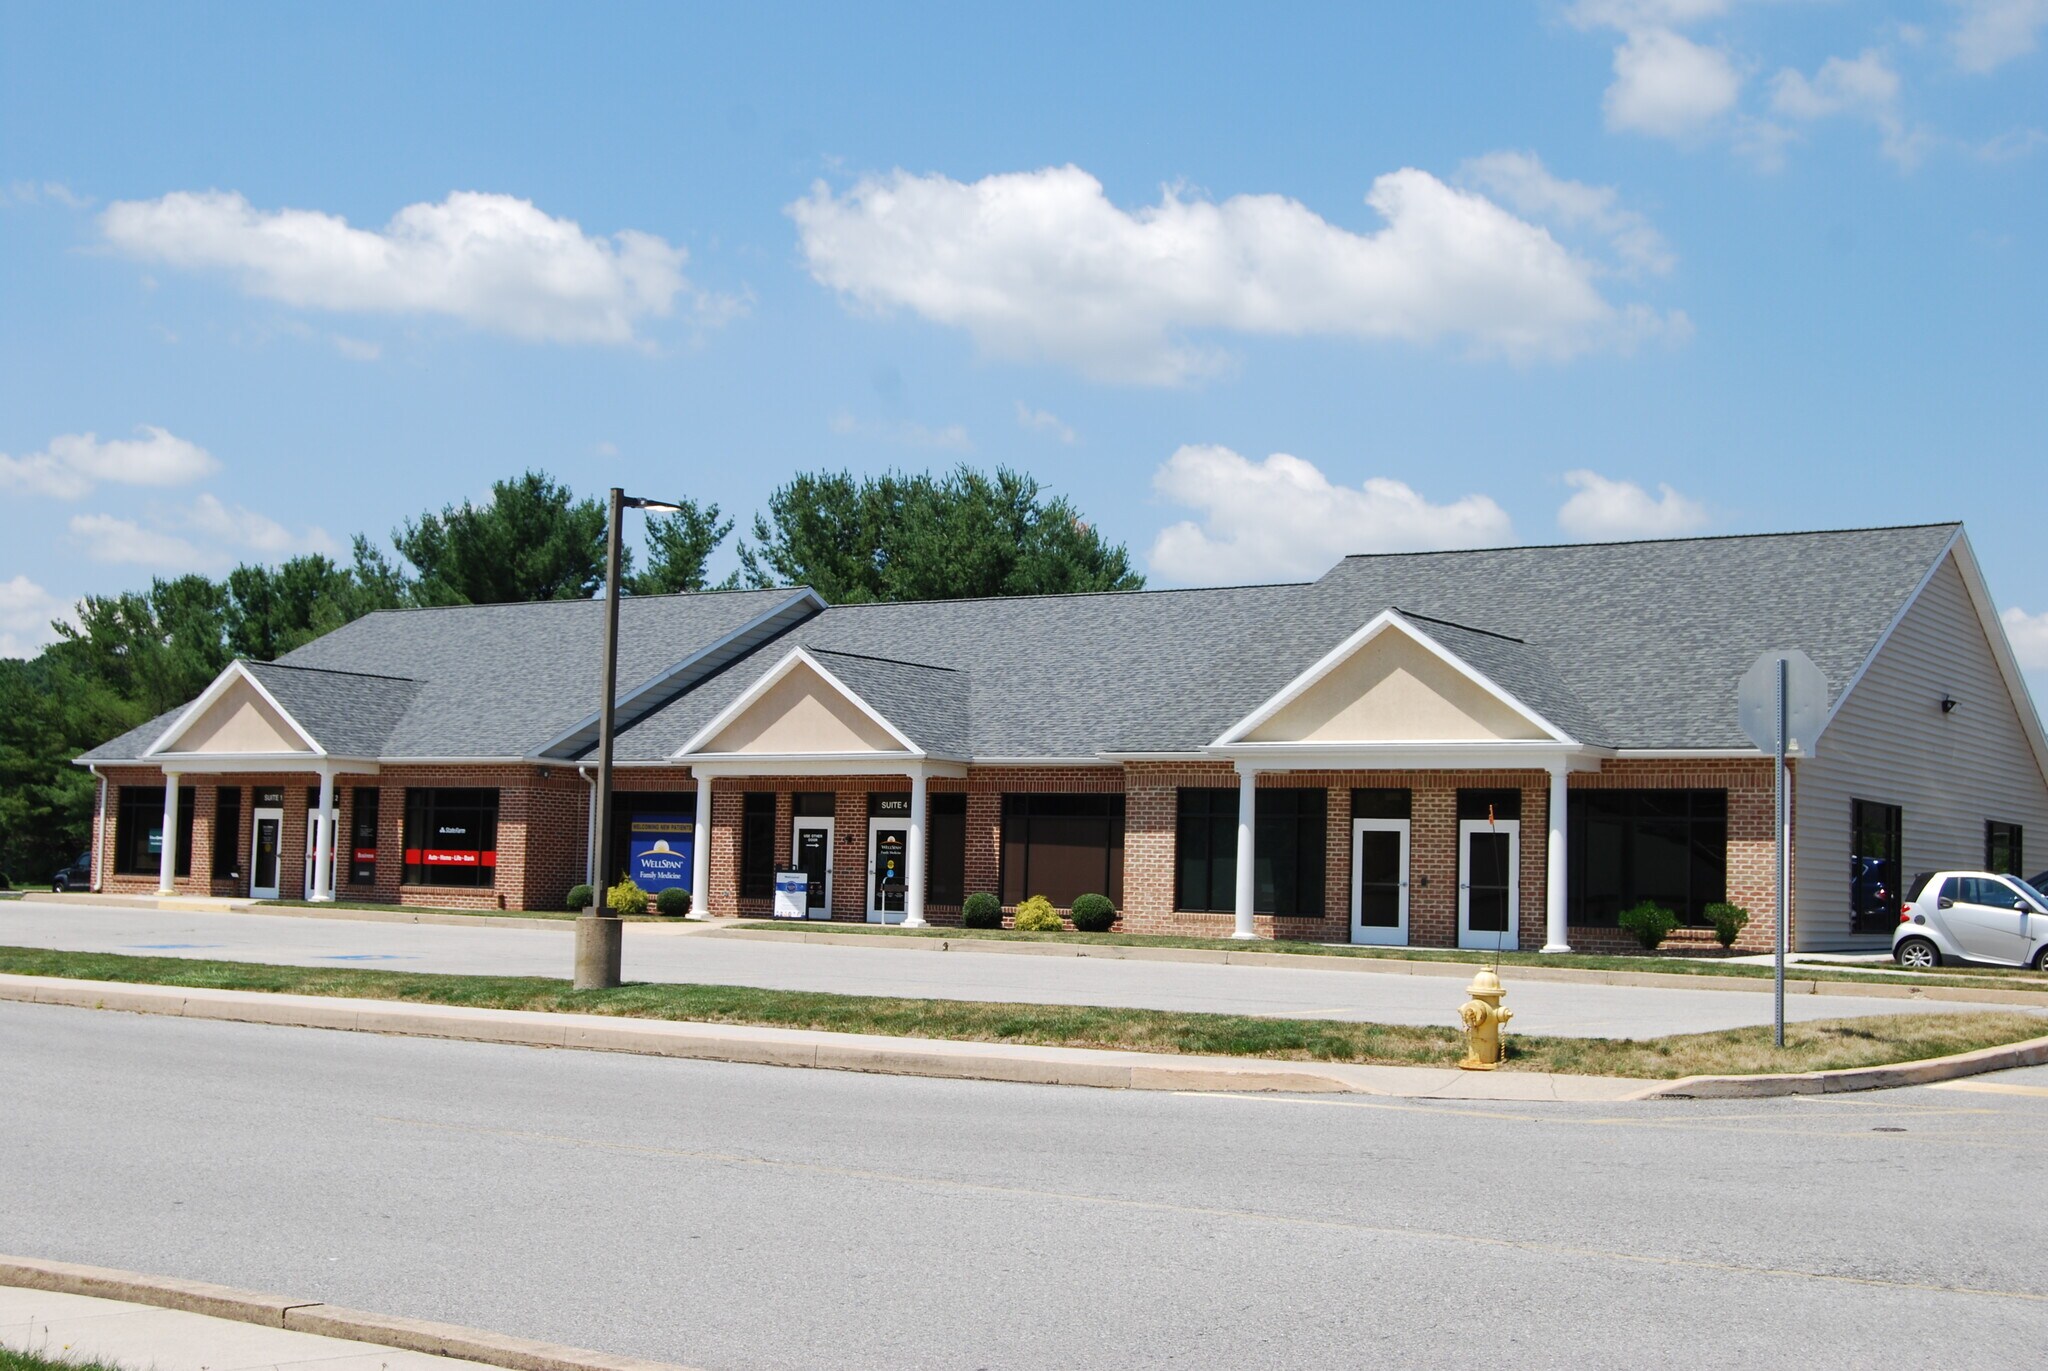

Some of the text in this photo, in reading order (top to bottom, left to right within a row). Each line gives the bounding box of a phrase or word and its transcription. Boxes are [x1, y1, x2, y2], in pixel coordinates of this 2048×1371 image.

[881, 801, 902, 809] SUITE
[640, 871, 682, 880] Family Medicine
